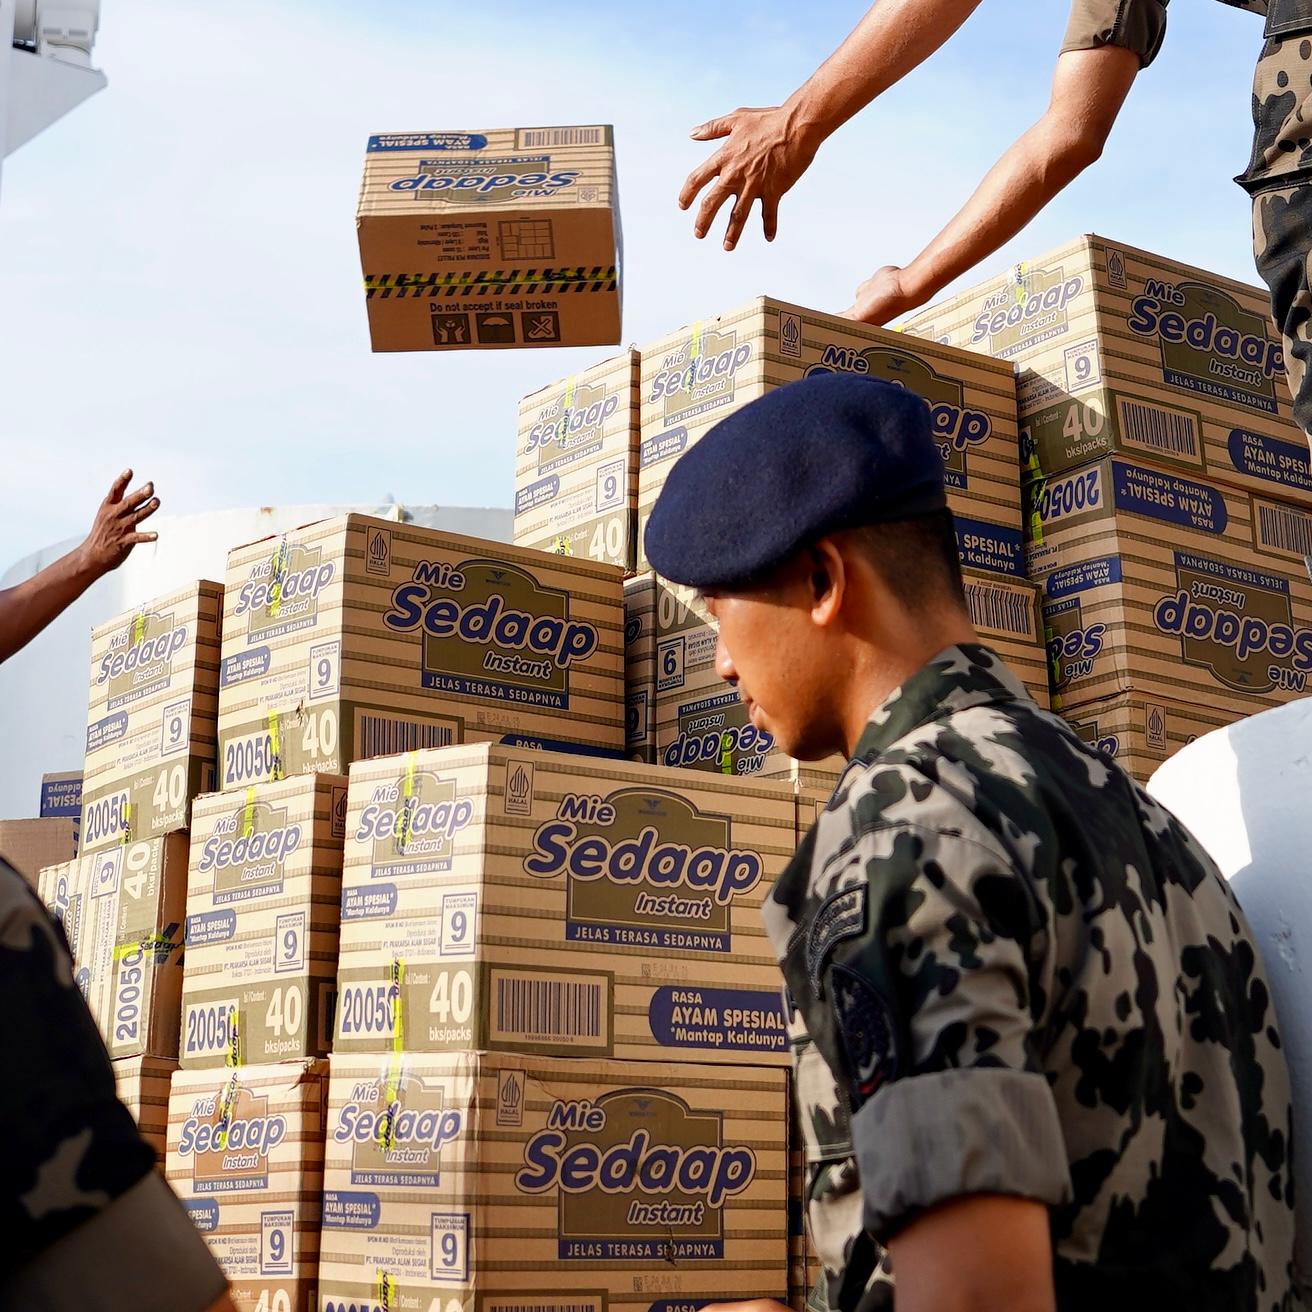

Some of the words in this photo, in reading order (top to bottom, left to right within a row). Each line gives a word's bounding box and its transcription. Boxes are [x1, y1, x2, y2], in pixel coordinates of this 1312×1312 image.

[437, 138, 472, 147] AYAM
[389, 171, 583, 193] Sedaap
[434, 167, 497, 176] Instant
[511, 188, 559, 198] Mie
[983, 291, 1008, 311] Mie
[1144, 278, 1186, 307] Mie
[430, 302, 443, 313] Do
[445, 303, 461, 312] not
[463, 303, 494, 314] accept
[496, 302, 503, 312] if
[505, 301, 523, 311] seal
[525, 300, 558, 310] broken
[970, 276, 1085, 344] Sedaap
[1020, 312, 1057, 336] Instant
[1127, 294, 1289, 380] Sedaap
[662, 352, 686, 370] Mie
[821, 344, 870, 374] Mie
[1074, 356, 1092, 380] 9
[648, 341, 754, 404] Sedaap
[1208, 358, 1264, 388] Instant
[691, 380, 726, 400] Instant
[1170, 375, 1195, 390] JELAS
[1197, 381, 1230, 399] TERASA
[1231, 390, 1274, 411] SEDAPNYA
[524, 392, 620, 455] Sedaap
[538, 404, 559, 421] Mie
[1062, 397, 1105, 442] 40
[1065, 435, 1108, 459] bks/packs
[1241, 433, 1264, 449] RASA
[1243, 446, 1277, 465] AYAM
[603, 475, 617, 500] 9
[1126, 470, 1172, 490] Kaldunya
[1284, 471, 1312, 488] Kaldun
[1041, 469, 1100, 521] 20050
[1178, 495, 1213, 516] AYAM
[1191, 515, 1214, 530] RASA
[589, 517, 624, 561] 40
[250, 560, 272, 580] Mie
[967, 550, 1016, 572] Kaldunya
[1180, 554, 1225, 575] SEDAPNYA
[412, 560, 466, 591] Mie
[1086, 567, 1110, 581] AYAM
[1226, 567, 1259, 584] TERASA
[1260, 574, 1284, 590] JELAS
[234, 560, 337, 617] Sedaap
[1192, 581, 1246, 610] Instant
[383, 581, 600, 670] Sedaap
[108, 629, 129, 651] Mie
[96, 626, 189, 686] Sedaap
[483, 650, 553, 679] Instant
[663, 649, 677, 676] 9
[1065, 658, 1094, 678] Mie
[132, 663, 164, 684] Instant
[317, 658, 332, 687] 9
[1268, 665, 1308, 692] Mie
[429, 677, 461, 691] JELAS
[465, 682, 505, 699] TERASA
[508, 689, 562, 707] SEDAPNYA
[713, 694, 735, 707] TERASA
[682, 698, 712, 714] SEDAPNYA
[169, 716, 183, 743] 9
[302, 708, 338, 759] 40
[688, 713, 726, 733] Instant
[515, 739, 544, 750] RASA
[665, 723, 776, 769] Sedaap
[226, 734, 274, 784] 20050
[302, 758, 338, 774] bks/packs
[737, 753, 766, 776] Mie
[48, 783, 82, 794] aldunya
[151, 762, 186, 814] 40
[372, 784, 400, 804] Mie
[43, 794, 82, 810] PESIAL
[556, 793, 616, 824] Mie
[85, 793, 128, 844] 20050
[151, 808, 185, 829] bks/packs
[214, 816, 238, 835] Mie
[356, 797, 473, 843] Sedaap
[198, 823, 303, 874] Sedaap
[100, 861, 115, 884] 9
[124, 841, 151, 901] 40
[241, 862, 277, 881] Instant
[523, 826, 763, 906] Sedaap
[635, 891, 712, 920] Instant
[450, 910, 467, 943] 9
[575, 926, 610, 940] JELAS
[615, 929, 659, 945] TERASA
[663, 933, 723, 950] SEDAPNYA
[283, 929, 298, 960] 9
[116, 948, 145, 1042] 20050
[429, 969, 474, 1024] 40
[671, 991, 703, 1004] RASA
[265, 985, 302, 1037] 40
[342, 985, 398, 1033] 20050
[671, 1006, 718, 1026] AYAM
[723, 1010, 786, 1030] SPESIAL
[187, 1004, 237, 1052] 20050
[429, 1025, 472, 1044] bks/packs
[727, 1030, 786, 1050] Kaldunya
[264, 1038, 301, 1055] bks/packs
[352, 1082, 379, 1102] Mie
[192, 1098, 216, 1118] Mie
[547, 1099, 606, 1131] Mie
[178, 1114, 288, 1157] Sedaap
[334, 1099, 463, 1150] Sedaap
[222, 1153, 259, 1170] Instant
[386, 1147, 430, 1163] Instant
[355, 1174, 373, 1184] JELAS
[374, 1175, 399, 1185] TERASA
[400, 1176, 436, 1186] SEDAPNYA
[514, 1128, 757, 1209] Sedaap
[196, 1182, 212, 1192] JELAS
[213, 1181, 234, 1191] TERASA
[235, 1178, 265, 1190] SEDAPNYA
[325, 1202, 344, 1214] AYAM
[627, 1199, 704, 1225] Instant
[270, 1229, 286, 1262] 9
[441, 1232, 458, 1267] 9
[567, 1242, 602, 1257] JELAS
[607, 1242, 652, 1257] TERASA
